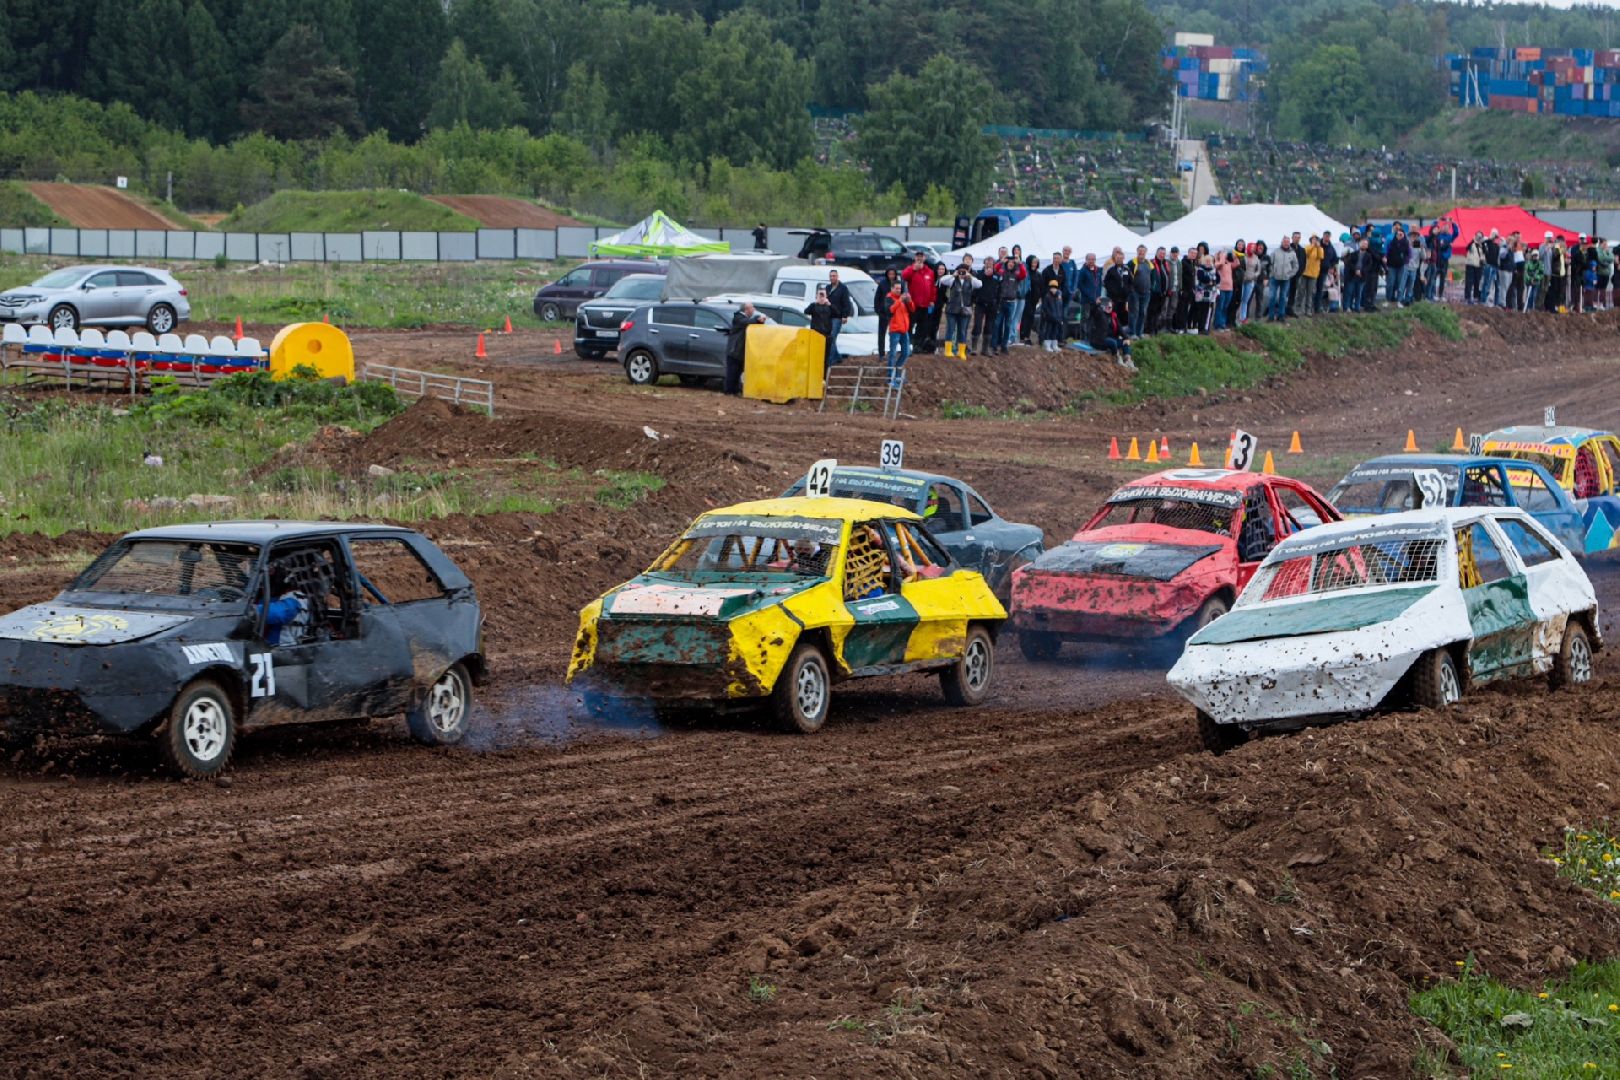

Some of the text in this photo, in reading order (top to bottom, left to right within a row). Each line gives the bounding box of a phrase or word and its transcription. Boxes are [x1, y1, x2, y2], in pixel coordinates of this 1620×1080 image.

[882, 443, 901, 465] 39
[1234, 434, 1251, 470] 3
[1471, 436, 1481, 455] 88
[810, 467, 829, 494] 42
[1112, 487, 1144, 500] ГОНКИ
[1144, 487, 1157, 497] НА
[1418, 473, 1444, 507] 52
[249, 652, 276, 697] 21
